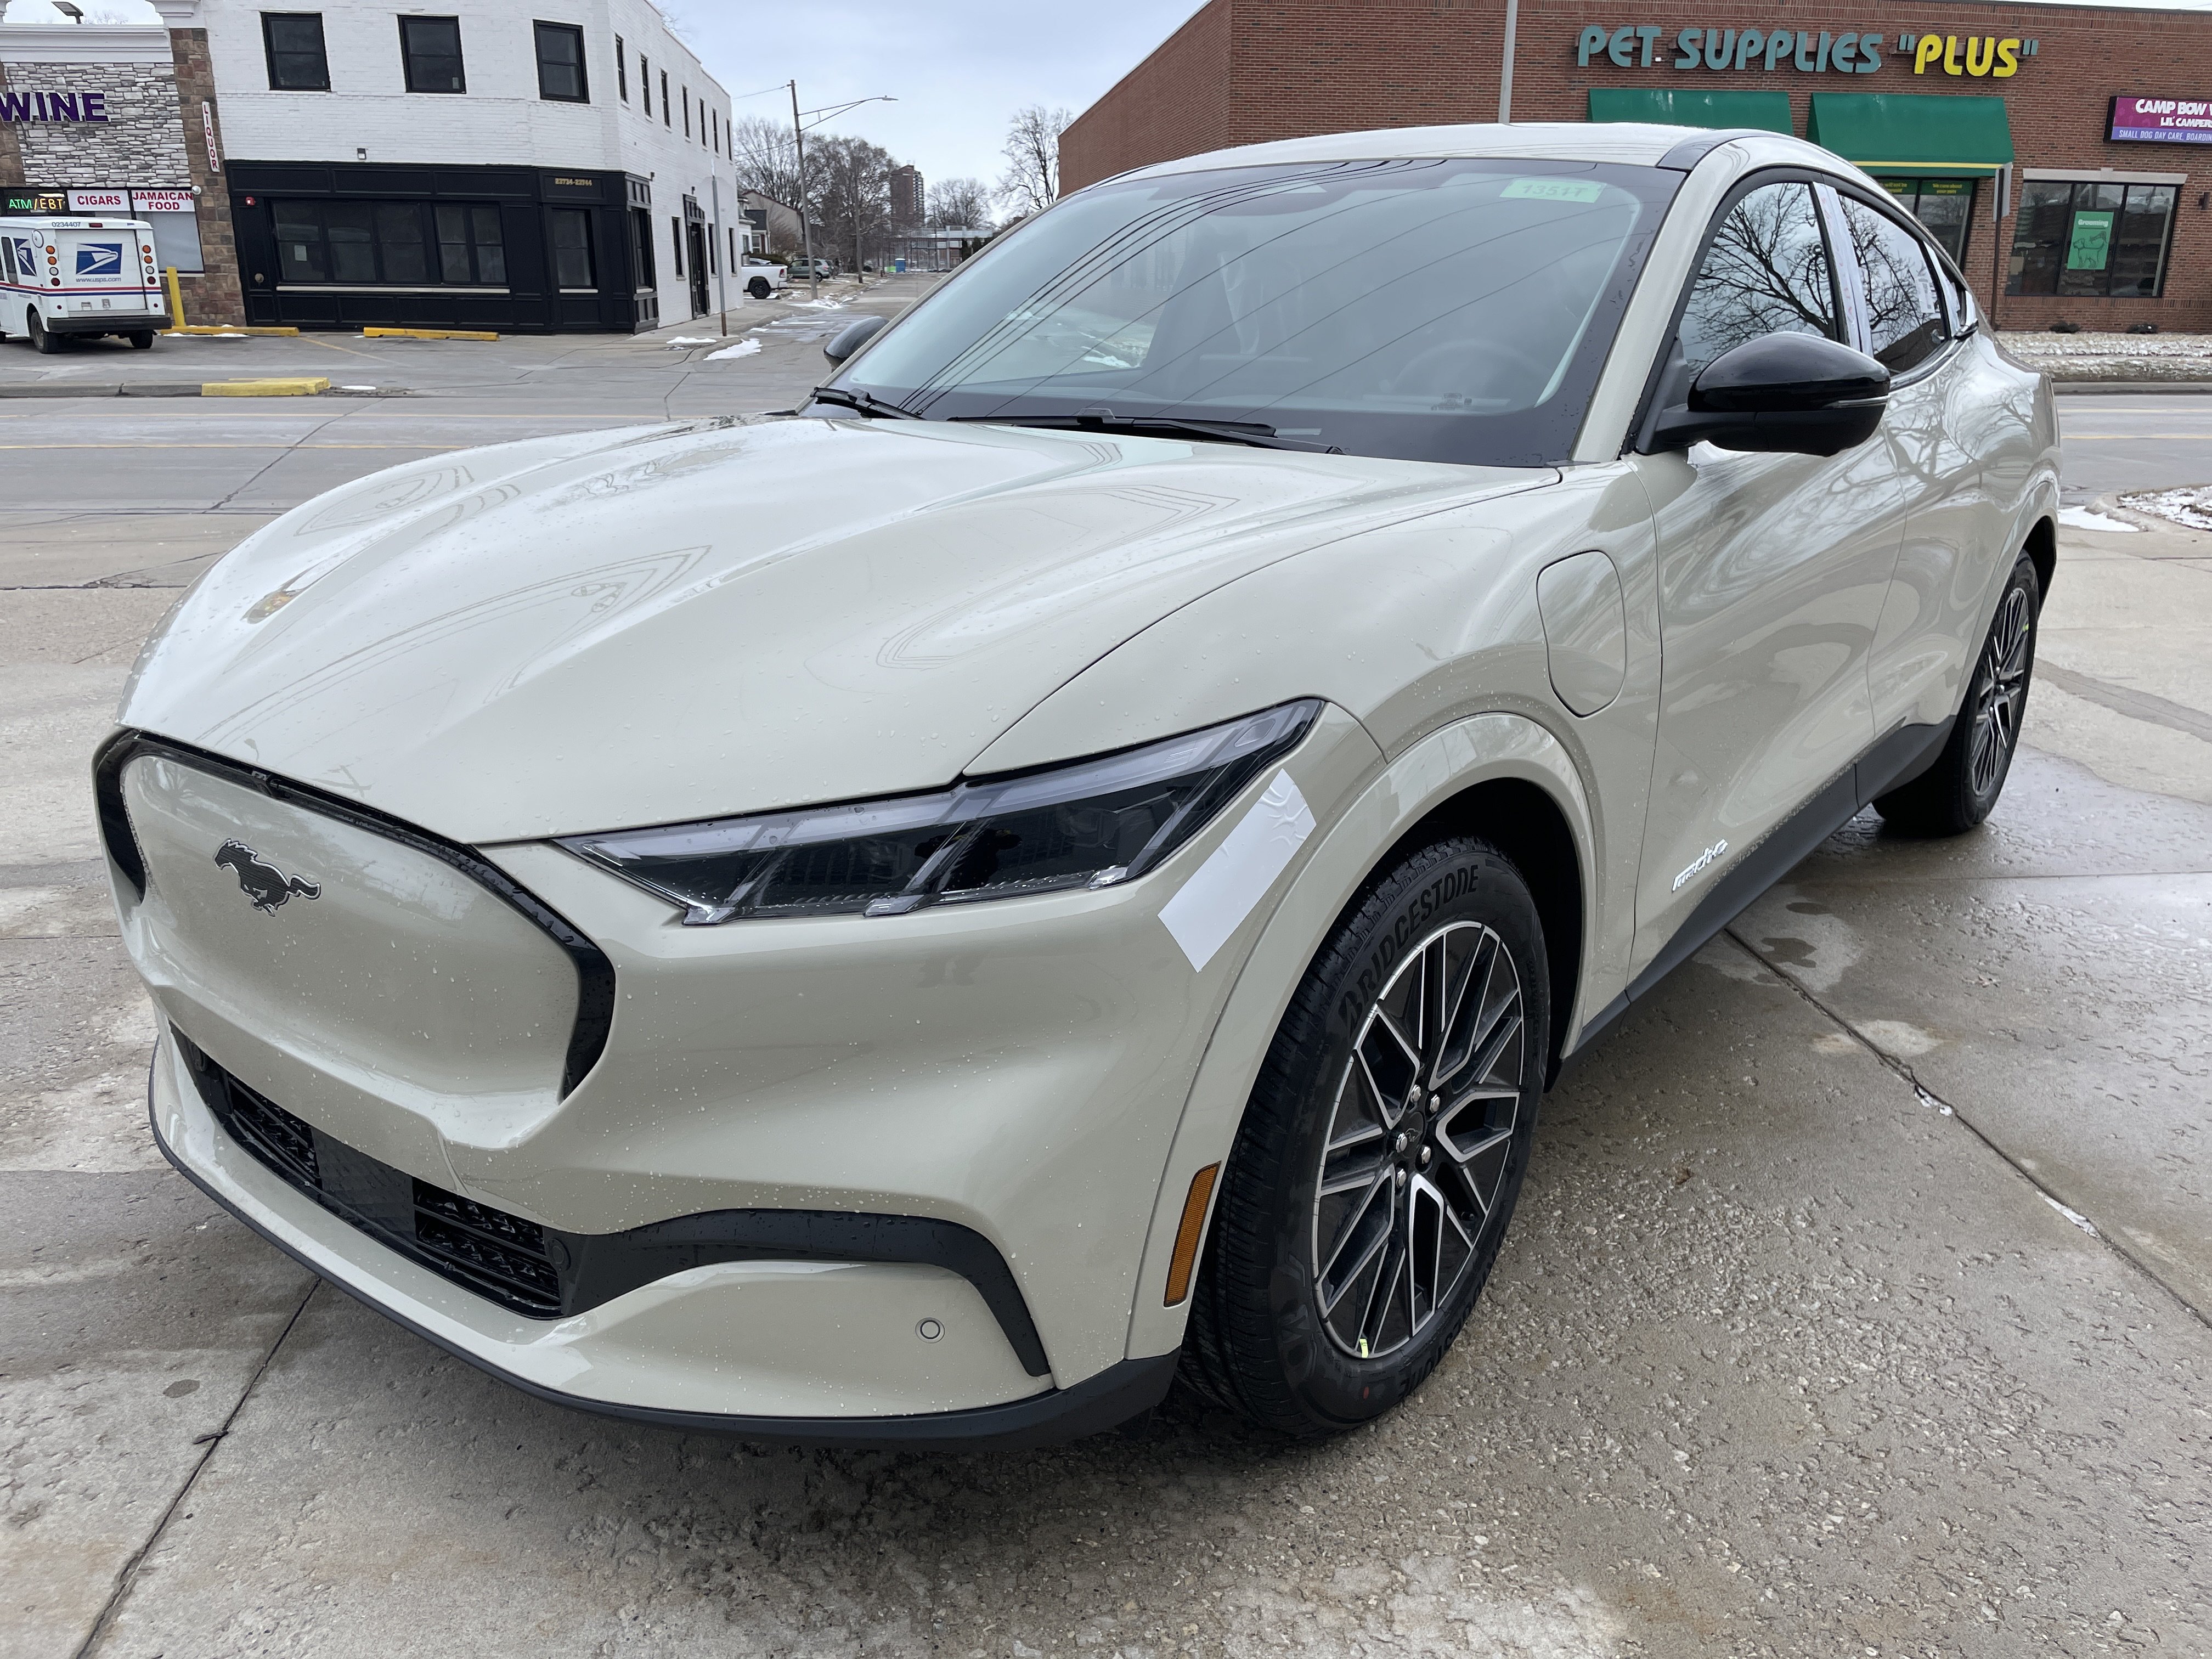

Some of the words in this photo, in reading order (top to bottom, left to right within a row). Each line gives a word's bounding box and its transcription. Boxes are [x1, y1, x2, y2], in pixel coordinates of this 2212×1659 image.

[1578, 25, 1662, 67] PET
[1674, 27, 1883, 74] SUPPLIES
[0, 92, 109, 122] WINE
[2135, 99, 2176, 114] CAMP
[2177, 101, 2208, 116] BOW
[204, 104, 218, 169] LIQUOR
[2119, 129, 2138, 139] SMALL
[2140, 131, 2153, 139] DOG
[2154, 131, 2167, 139] DAY
[77, 195, 121, 206] CIGARS
[132, 191, 194, 200] JAMAICAN
[8, 198, 63, 210] ATM/EBT
[148, 201, 180, 211] FOOD
[1338, 864, 1479, 1039] BRIDGESTONE
